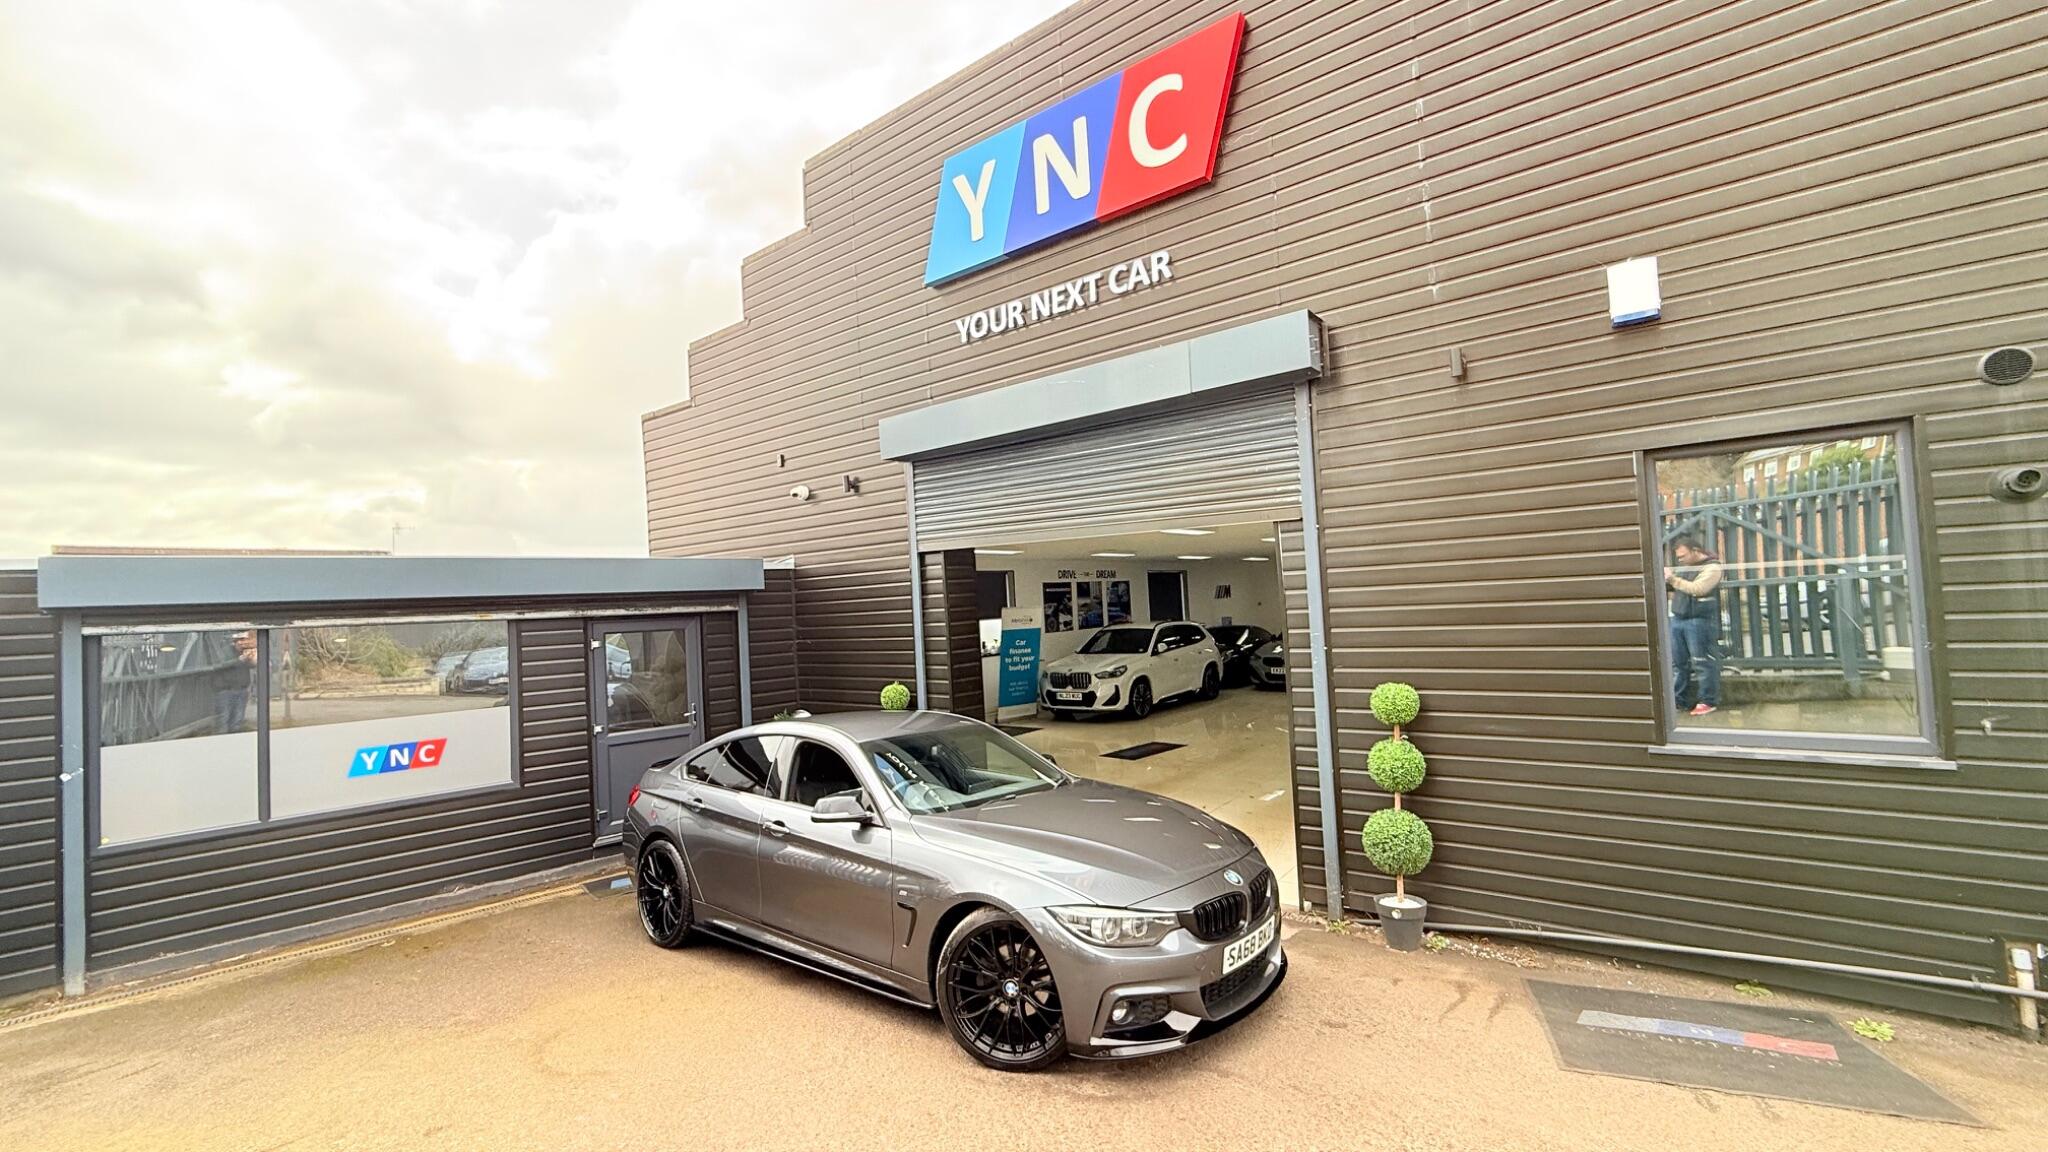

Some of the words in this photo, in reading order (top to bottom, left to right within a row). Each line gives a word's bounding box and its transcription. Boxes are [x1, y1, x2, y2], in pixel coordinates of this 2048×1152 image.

[952, 73, 1188, 242] YNC
[955, 301, 1024, 343] YOUR
[1030, 273, 1102, 322] NEXT
[1108, 250, 1172, 295] CAR
[1057, 569, 1077, 579] DRIVE
[1096, 569, 1116, 579] DREAM
[1008, 663, 1031, 672] budget
[1021, 655, 1035, 664] your
[360, 744, 436, 771] YNC
[1228, 934, 1256, 968] SA68
